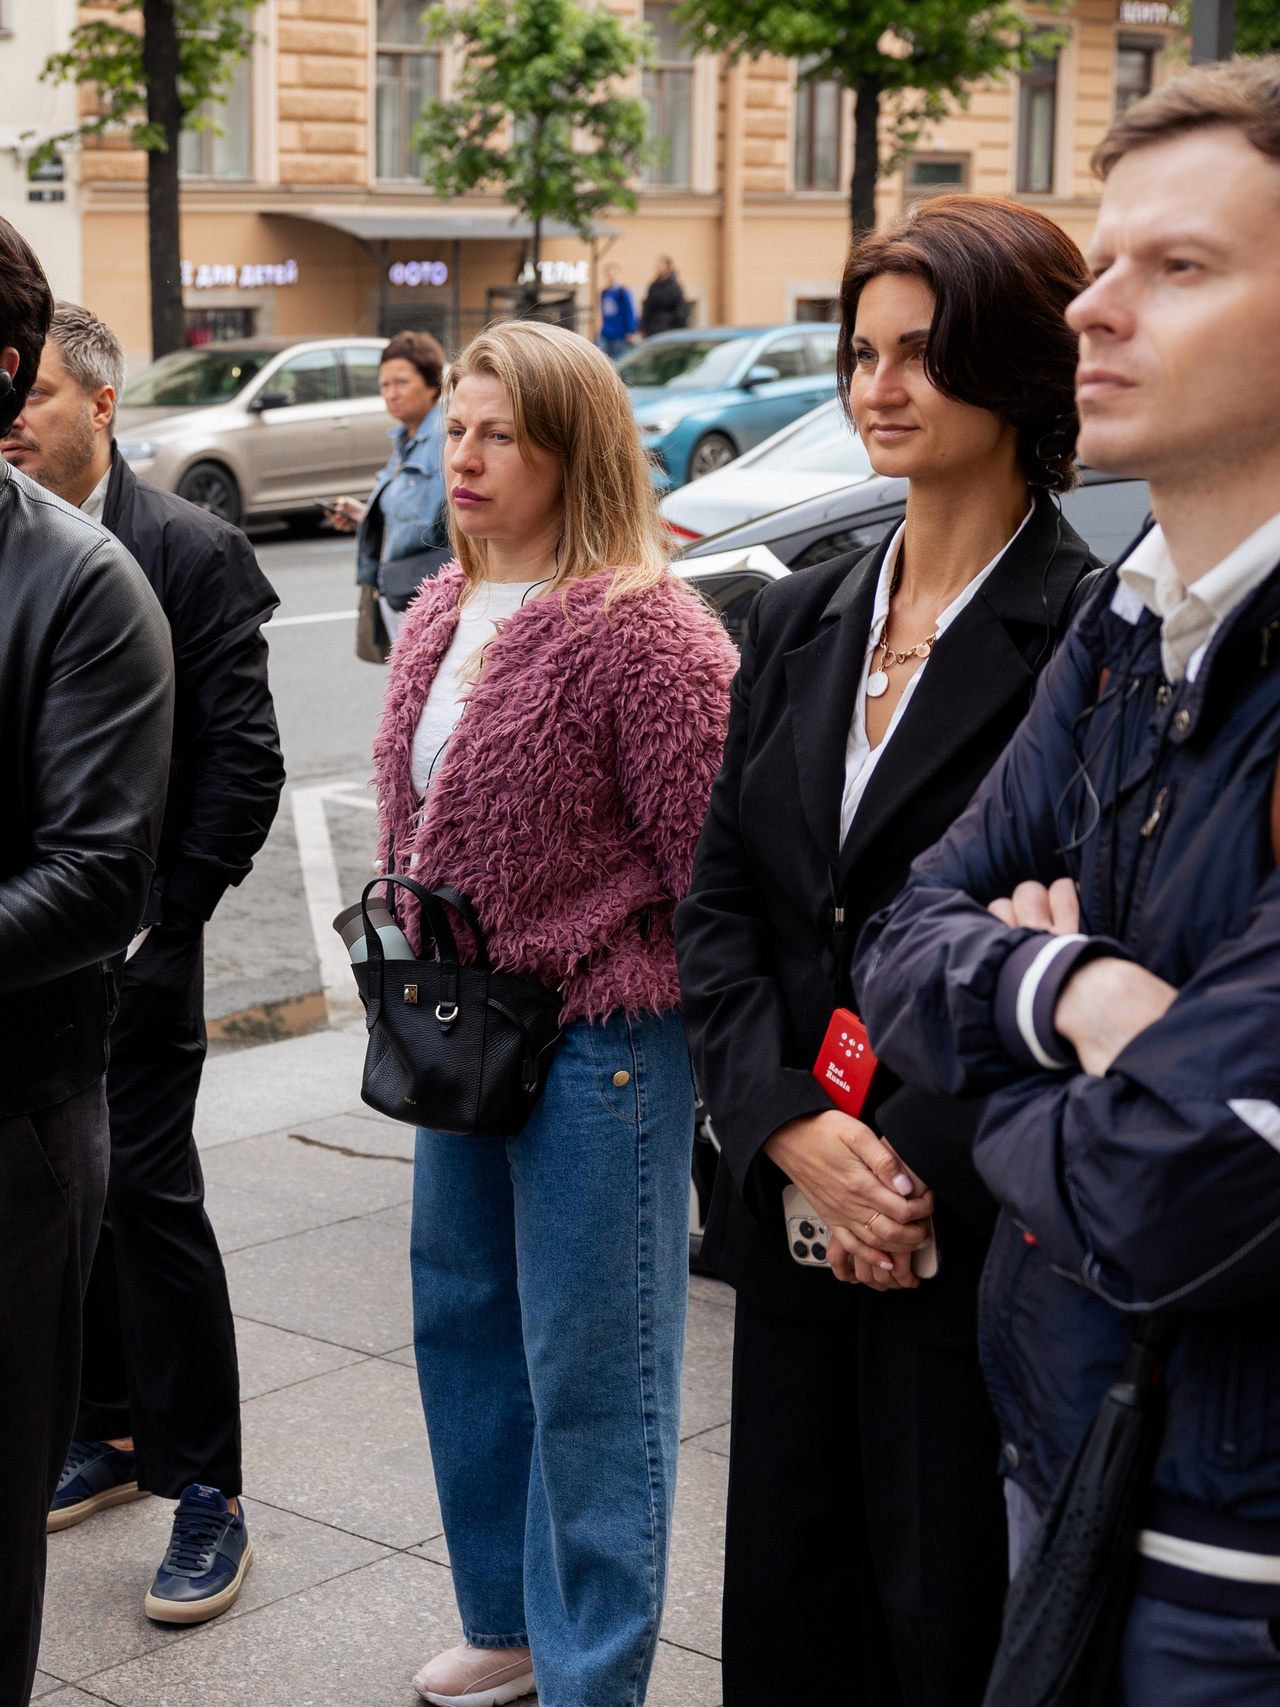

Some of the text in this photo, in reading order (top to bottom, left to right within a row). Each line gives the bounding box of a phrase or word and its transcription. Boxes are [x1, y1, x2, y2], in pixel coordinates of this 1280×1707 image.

[195, 264, 236, 288] ДЛЯ
[238, 259, 298, 288] ДЕТЕЙ
[389, 261, 448, 287] ФОТО
[826, 1070, 850, 1092] Russia
[829, 1062, 844, 1077] Red
